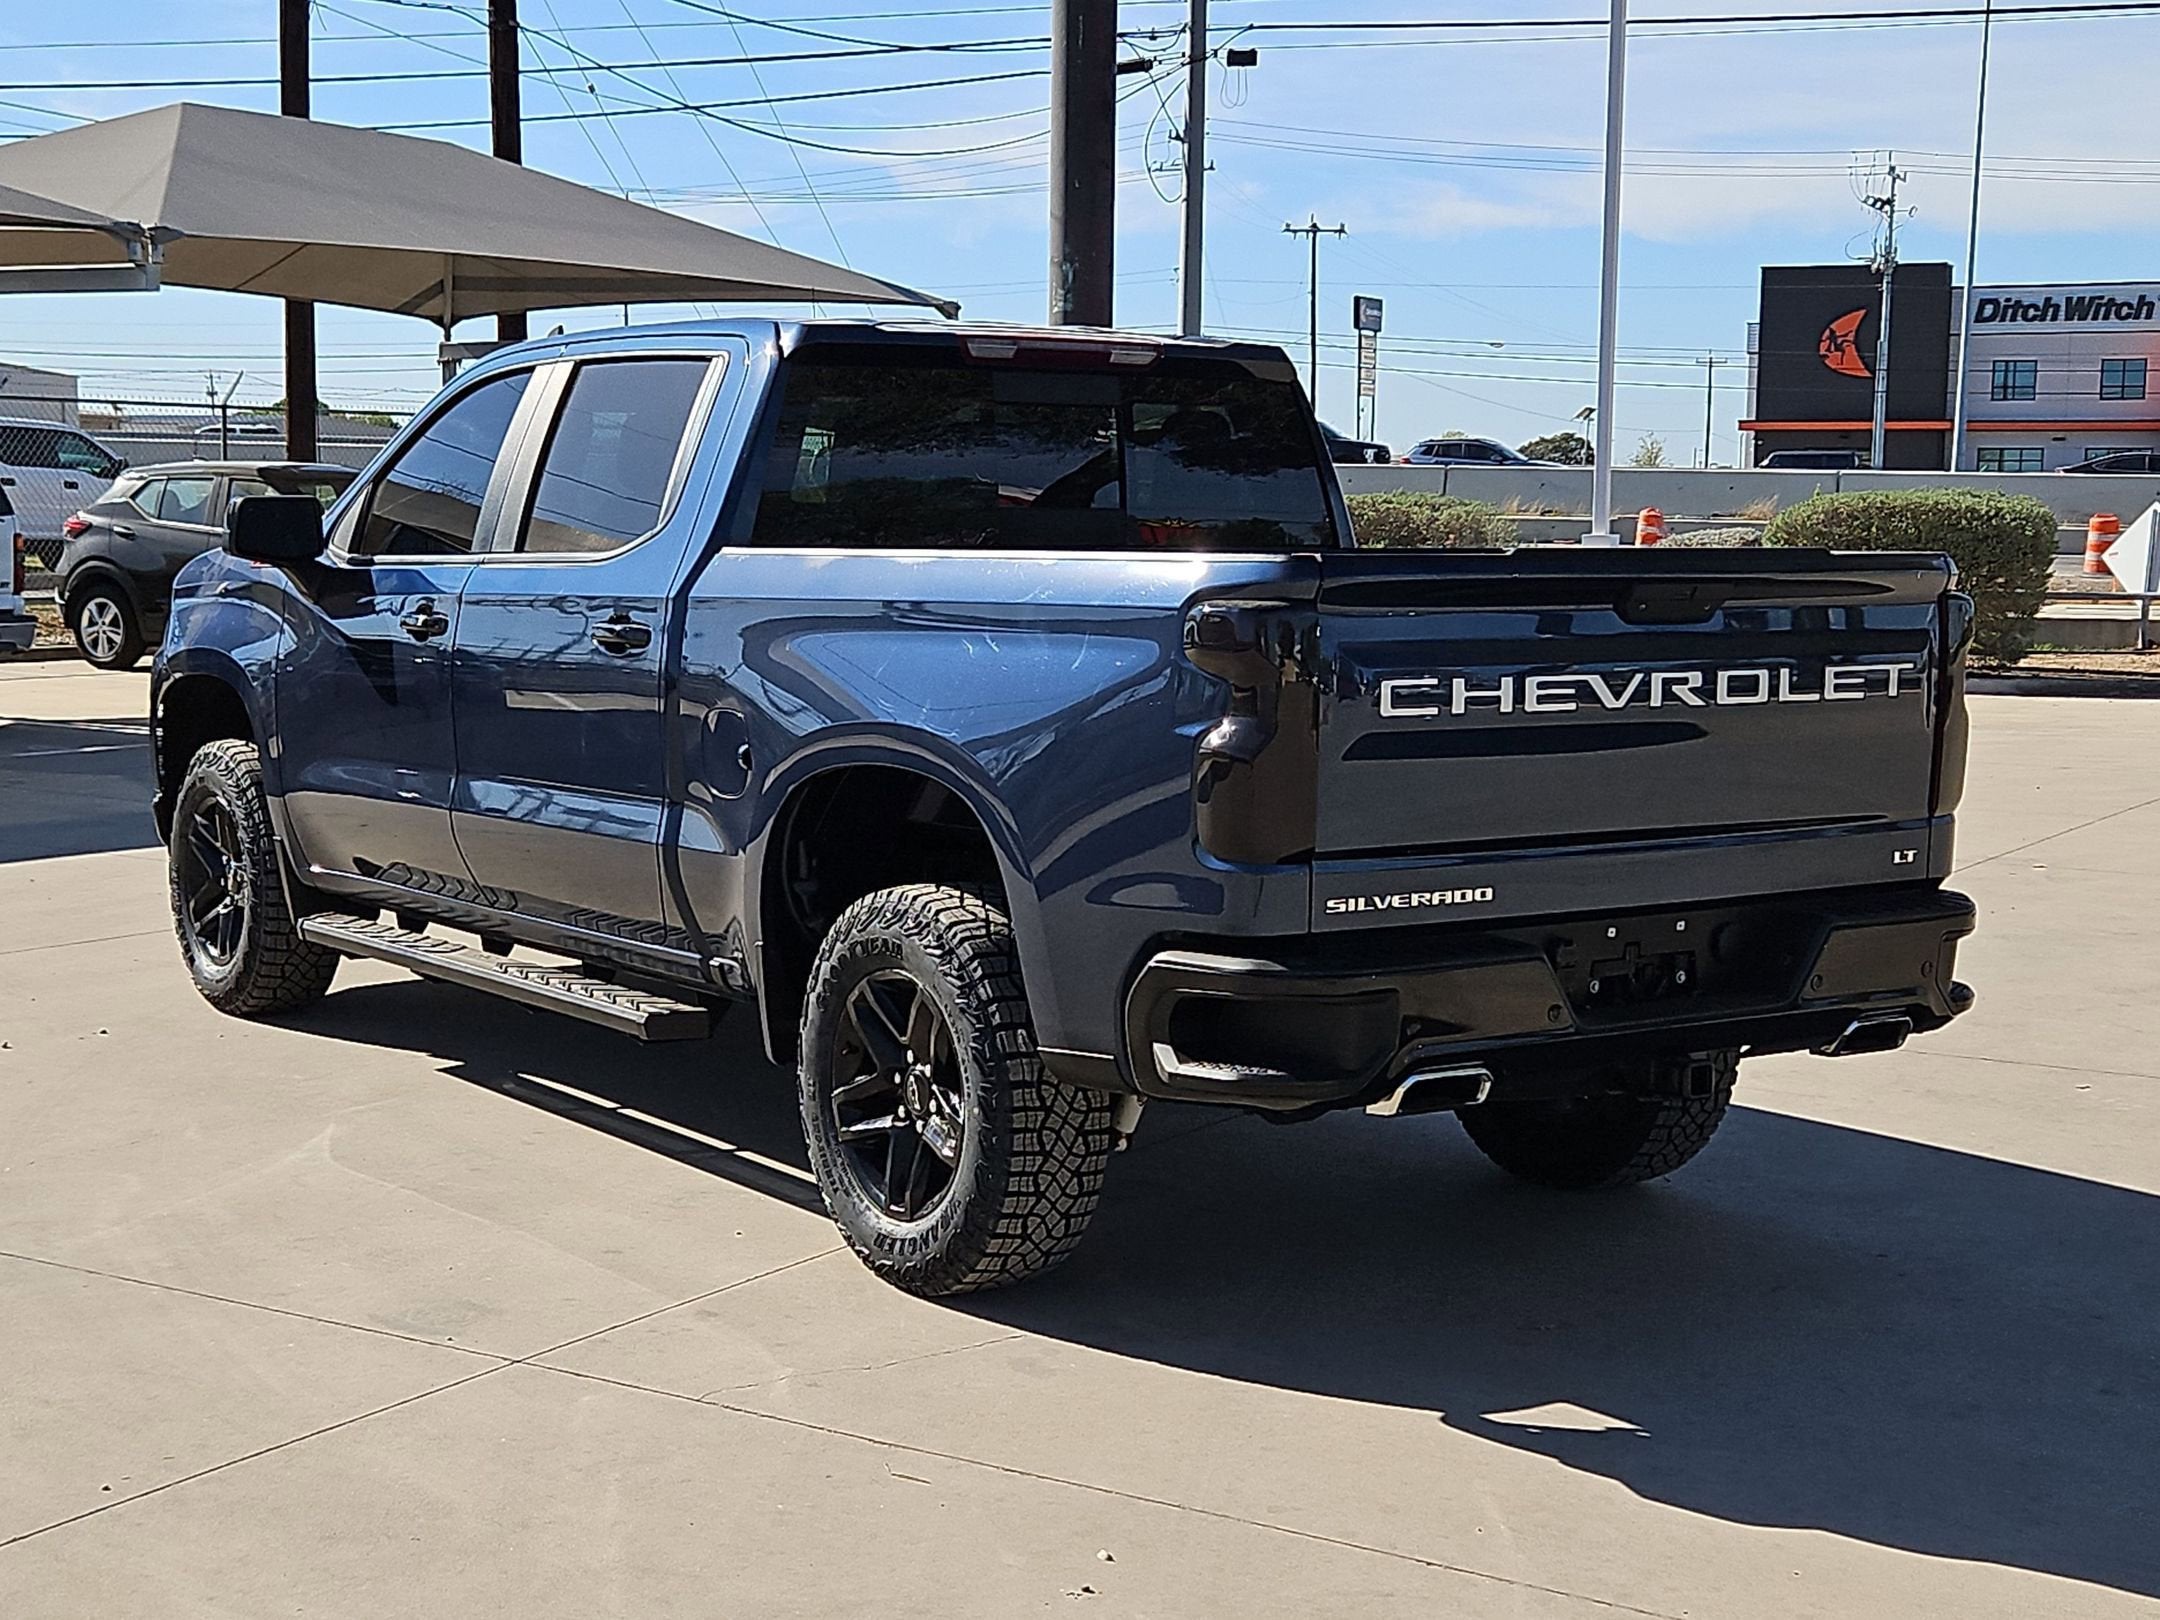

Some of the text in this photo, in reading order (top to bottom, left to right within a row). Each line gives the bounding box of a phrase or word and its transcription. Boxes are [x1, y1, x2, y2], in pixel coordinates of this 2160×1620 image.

[1974, 294, 2156, 323] Ditch Witch
[1379, 662, 1914, 717] CHEVROLET
[1892, 849, 1918, 864] LT
[1325, 886, 1494, 914] SILVERADO
